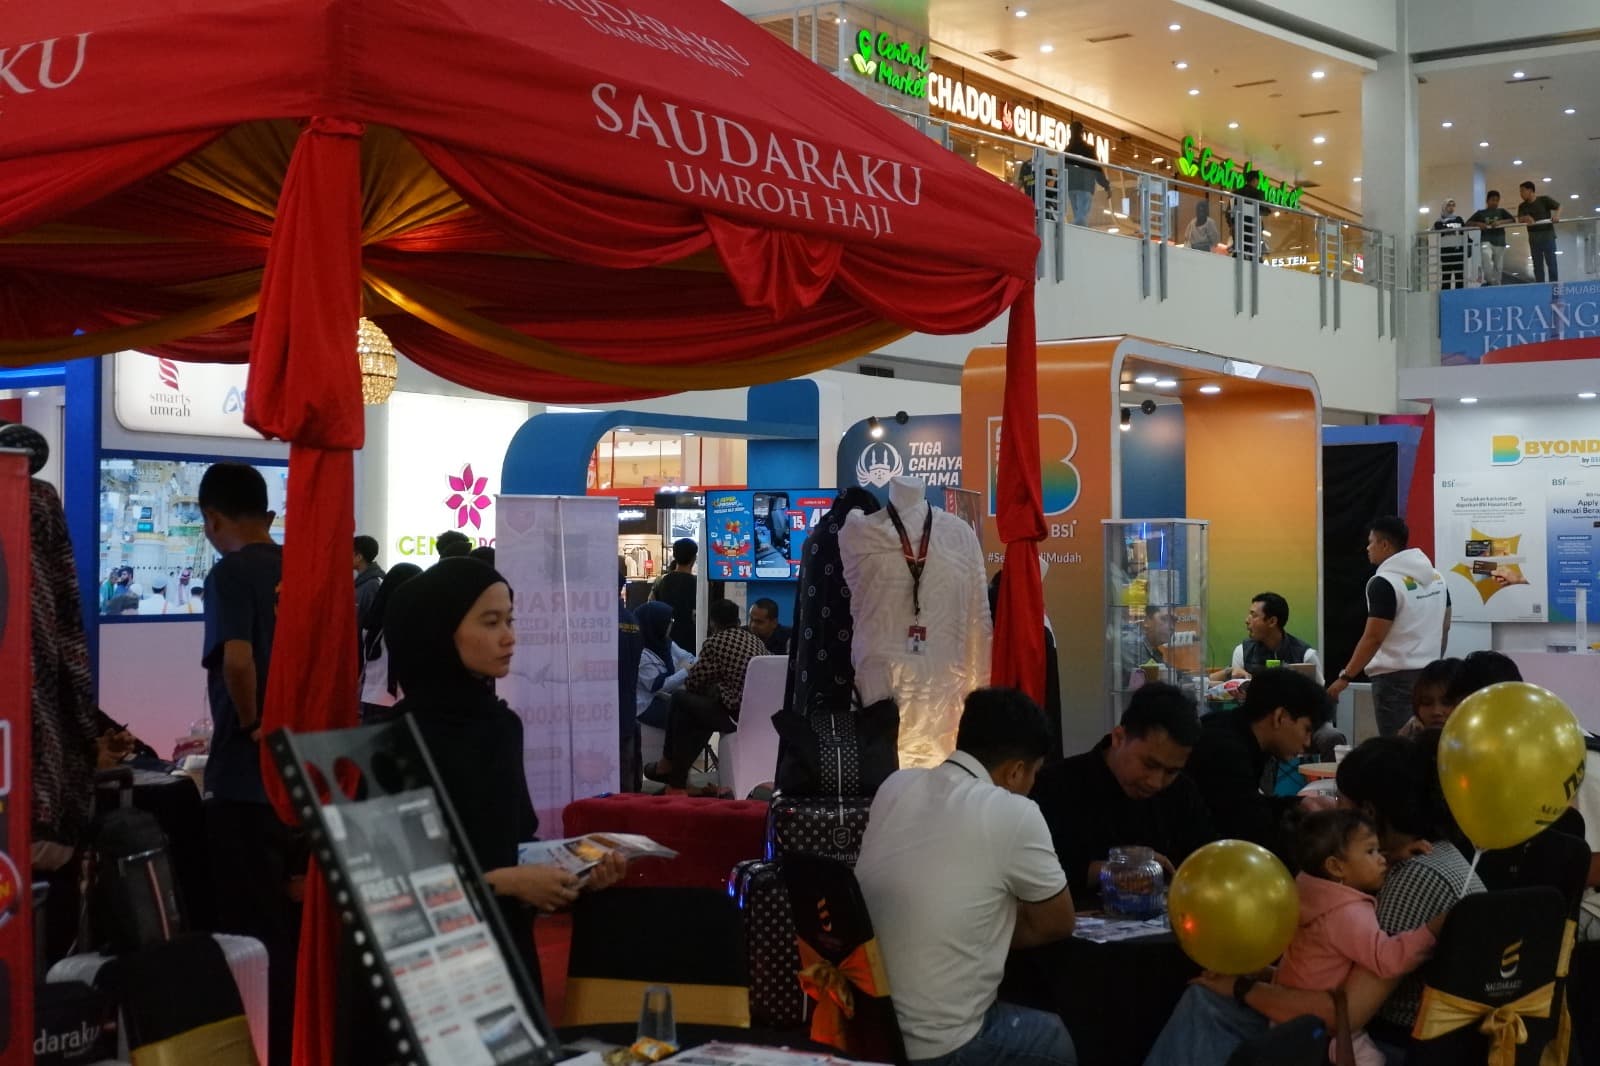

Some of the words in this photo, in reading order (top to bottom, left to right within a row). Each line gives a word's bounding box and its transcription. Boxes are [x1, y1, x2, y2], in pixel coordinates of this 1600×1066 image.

[877, 31, 930, 73] Central
[876, 60, 928, 99] Market
[928, 71, 1003, 130] CHADOL
[1013, 105, 1109, 164] GUJEON
[591, 83, 924, 206] SAUDARAKU
[665, 160, 812, 221] UMROH
[823, 196, 895, 240] HAJI
[1286, 255, 1307, 265] TEH
[150, 404, 191, 417] umrah
[908, 441, 942, 456] TIGA
[1525, 439, 1600, 456] BYOND
[908, 456, 962, 472] CAHAYA
[1051, 521, 1076, 538] BSI
